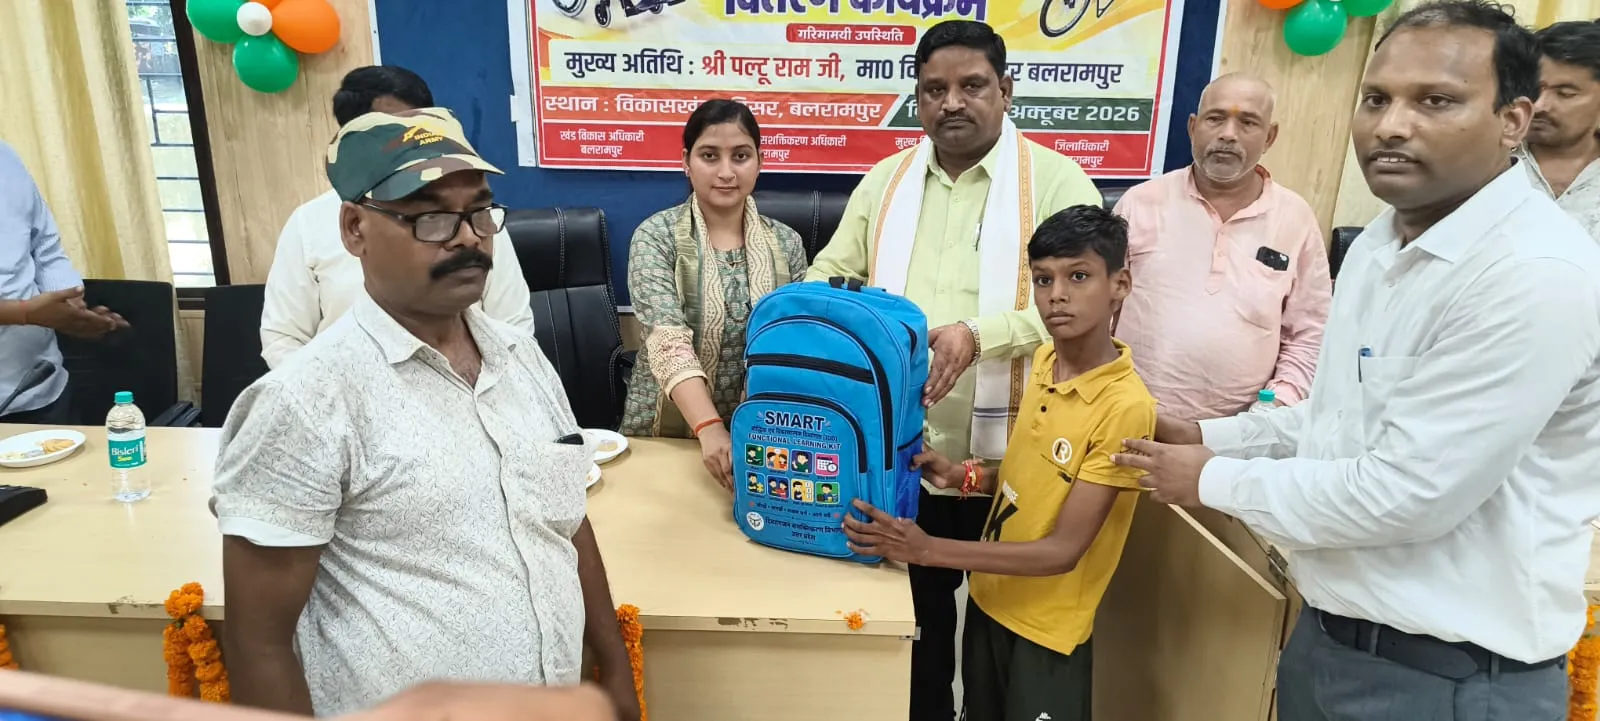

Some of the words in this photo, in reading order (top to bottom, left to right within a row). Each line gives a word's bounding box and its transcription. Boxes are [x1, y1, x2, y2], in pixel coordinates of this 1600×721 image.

[797, 27, 852, 41] गरिमामयी
[855, 27, 904, 42] उपस्थिति
[564, 52, 617, 78] मुख्य
[622, 48, 684, 75] अतिथि
[701, 49, 726, 77] श्री
[730, 56, 773, 85] पल्टू
[773, 58, 812, 78] राम
[816, 52, 845, 82] जी,
[1027, 63, 1124, 89] बलरामपुर
[543, 95, 599, 112] स्थान
[614, 93, 707, 114] विकासखं
[788, 101, 883, 122] बलरामपुर
[1008, 105, 1082, 126] अक्टूबर
[1085, 106, 1140, 121] 2026
[560, 129, 576, 141] खंड
[578, 128, 606, 141] विकास
[608, 129, 645, 142] अधिकारी
[810, 134, 847, 147] अधिकारी
[580, 144, 623, 158] बलरामपुर
[1055, 139, 1110, 152] जिलाधिकारी
[763, 149, 790, 161] रामपुर
[764, 410, 826, 431] SMART
[749, 433, 790, 445] FUNCTIONAL
[793, 438, 827, 450] LEARNING
[829, 443, 841, 451] KIT
